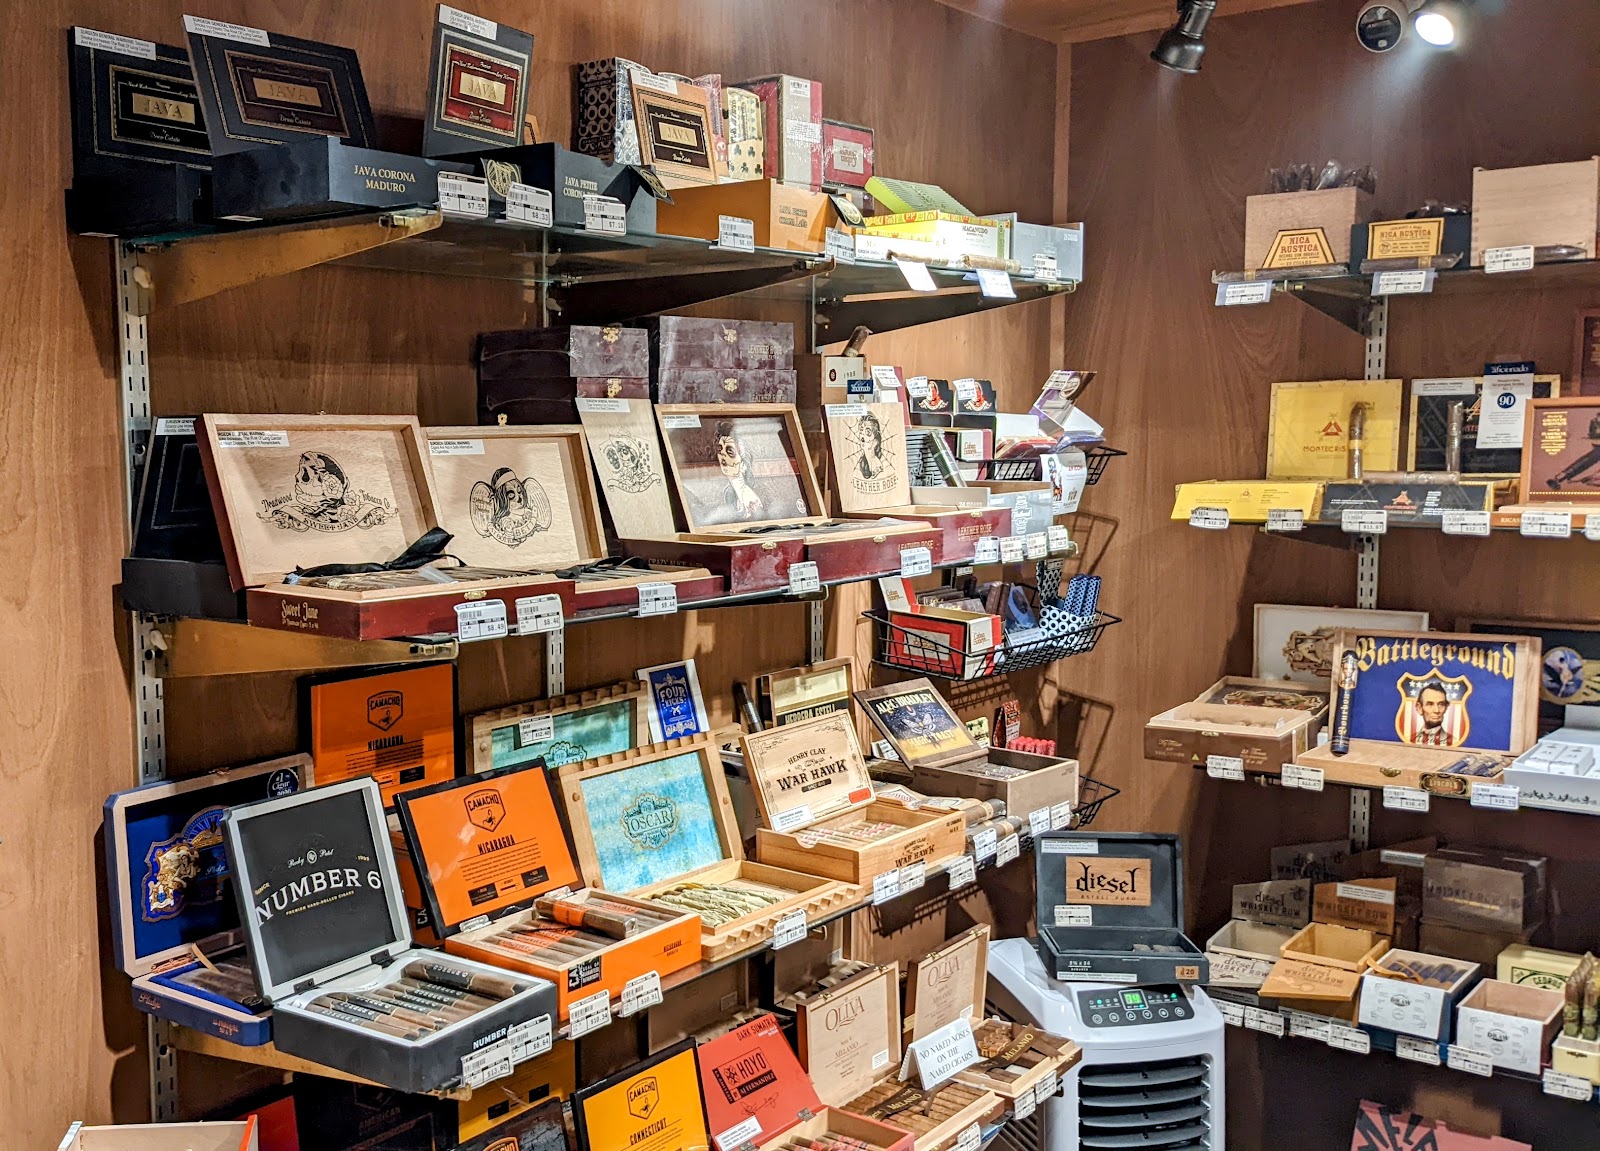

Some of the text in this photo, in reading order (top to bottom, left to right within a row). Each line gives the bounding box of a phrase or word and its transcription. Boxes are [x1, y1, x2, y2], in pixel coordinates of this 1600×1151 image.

[267, 83, 309, 102] JAVA
[468, 79, 497, 99] JAVA
[144, 99, 183, 120] JAVA
[667, 126, 690, 142] JAVA
[354, 164, 416, 183] JAVA CORONA
[365, 179, 406, 193] MADURO
[565, 176, 598, 191] JAVA PETITE
[961, 225, 989, 234] MACANUDO
[1400, 229, 1431, 237] RUSTICA
[1280, 244, 1318, 254] RUSTICA
[1289, 236, 1310, 245] NICA
[1499, 395, 1514, 405] 90
[1302, 445, 1347, 453] MONTECRIS
[852, 475, 898, 492] LEATHER ROSE
[261, 493, 293, 513] Deadwood
[359, 489, 383, 507] Tobacco
[957, 524, 992, 536] LEATHER ROSE
[920, 539, 934, 549] ROSE
[281, 599, 318, 621] Sweet Jane
[1355, 637, 1515, 680] Battleground
[369, 695, 401, 710] CAMACHO
[659, 687, 686, 700] FOUR
[665, 698, 684, 707] KICKS
[876, 693, 936, 715] ALEC BRADLEY
[1339, 691, 1350, 737] Bourbon
[367, 734, 404, 752] NICARAGUA
[907, 729, 955, 747] MAGIC TOAST
[787, 747, 827, 765] HENRY CLAY
[776, 773, 809, 791] WAR
[810, 758, 848, 780] HAWK
[271, 779, 292, 791] Cigar
[467, 795, 501, 812] CAMACHO
[630, 811, 671, 832] OSCAR
[319, 848, 335, 858] Patel
[477, 834, 516, 854] NICARAGUA
[894, 844, 935, 868] WAR HAWK
[1076, 861, 1141, 894] diesel
[255, 867, 383, 928] NUMBER 6
[285, 889, 355, 916] PREMIUM HAND-ROLLED CIGARS
[1255, 890, 1285, 907] diesel
[1240, 901, 1300, 917] WHISKEY ROW
[1316, 901, 1388, 919] WHISKEY ROW
[928, 955, 960, 987] OLIVA
[1224, 957, 1256, 969] diesel
[1301, 965, 1332, 976] diesel
[1250, 969, 1270, 978] ROW
[1284, 968, 1344, 985] WHISKEY ROW
[825, 995, 865, 1031] OLIVA
[736, 1028, 752, 1041] DARK
[750, 1017, 775, 1034] SUMATRA
[472, 1027, 507, 1050] NUMBER
[919, 1027, 970, 1060] NO NAKED NOSES
[1002, 1033, 1034, 1061] MELANIO
[936, 1046, 959, 1064] ON THE
[736, 1052, 767, 1079] HOYO
[929, 1050, 974, 1080] NAKED CIGARS!
[745, 1072, 775, 1091] FERNANDEZ
[628, 1080, 657, 1102] CAMACHO
[886, 1093, 922, 1110] MELANIO
[629, 1117, 668, 1146] CONNECTICUT
